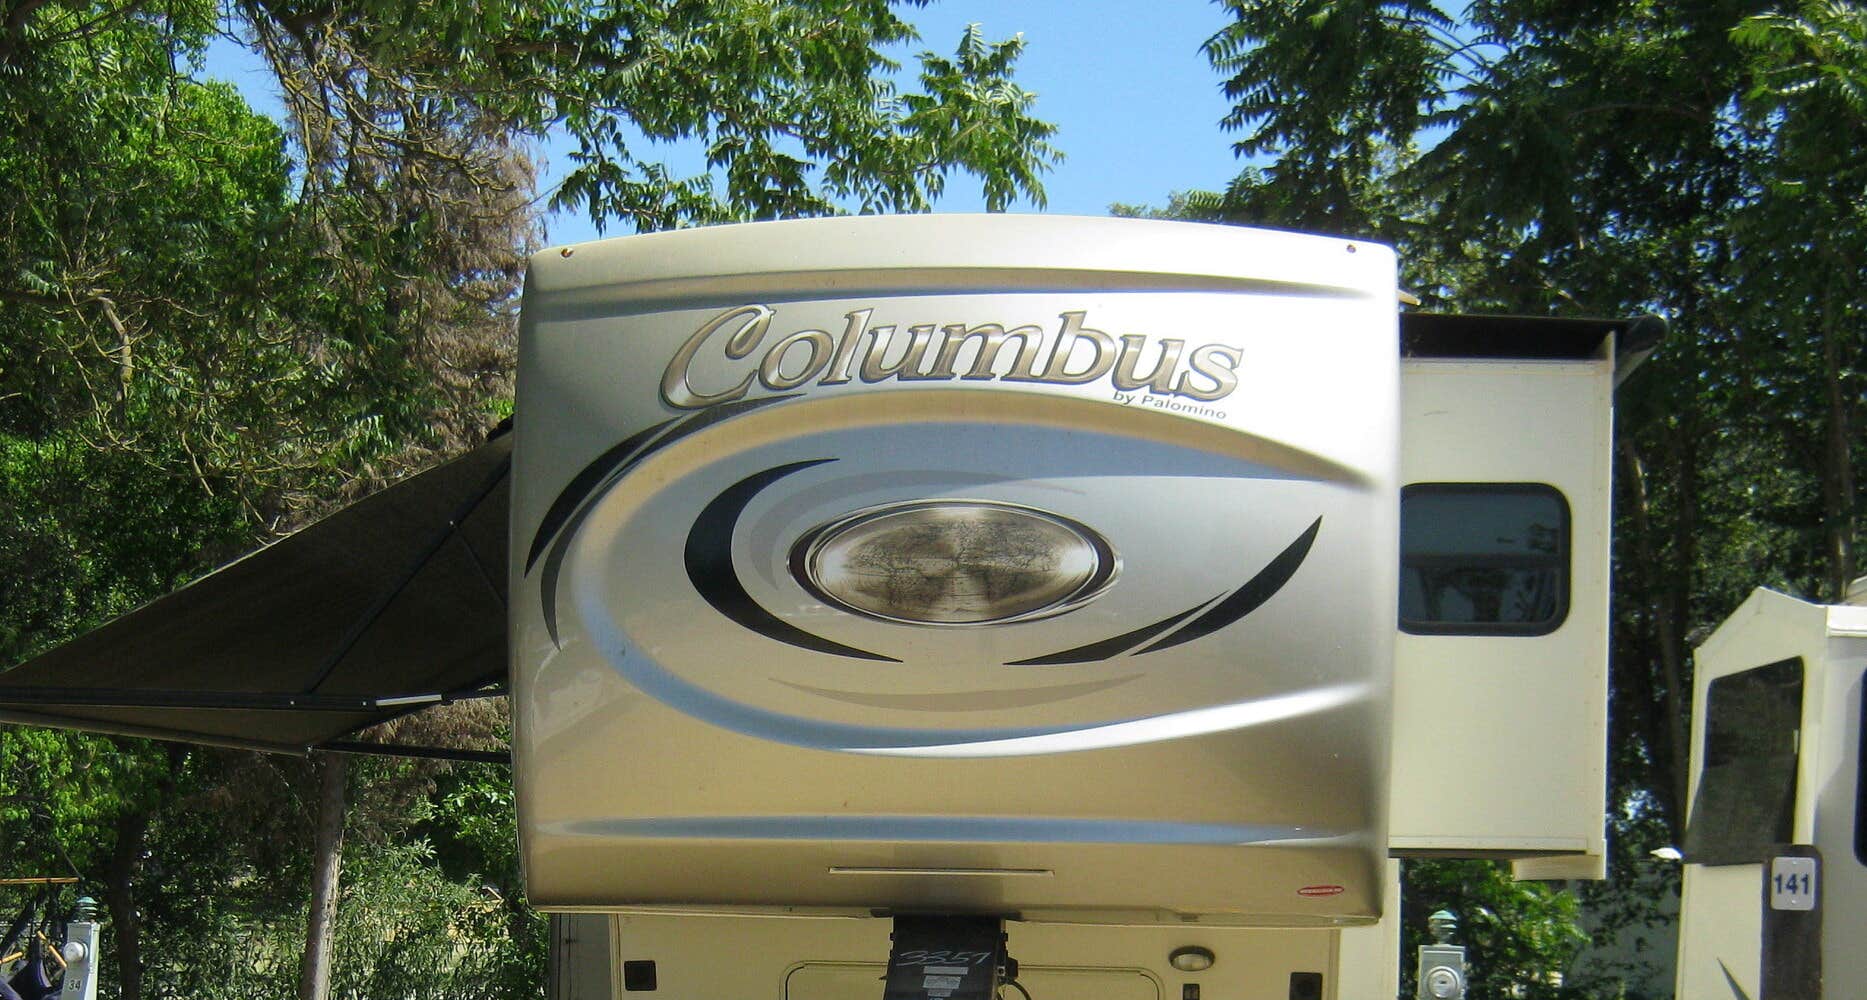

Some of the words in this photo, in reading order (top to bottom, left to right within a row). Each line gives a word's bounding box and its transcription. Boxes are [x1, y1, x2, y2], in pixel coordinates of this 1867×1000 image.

[660, 304, 1244, 411] Columbus
[1112, 390, 1135, 405] by
[1142, 395, 1227, 419] Palomino
[1774, 873, 1810, 895] 141
[69, 980, 81, 991] 34
